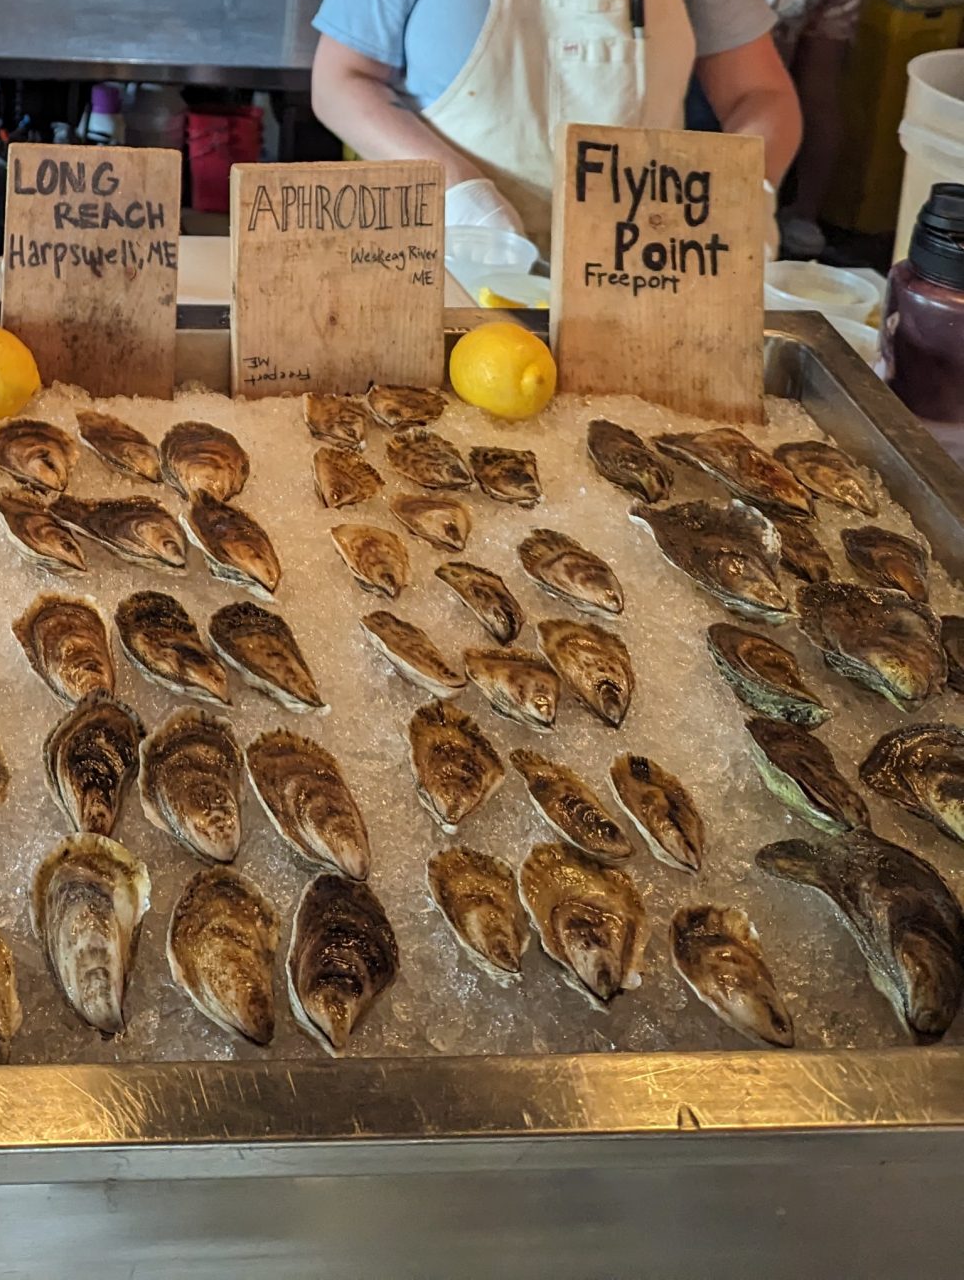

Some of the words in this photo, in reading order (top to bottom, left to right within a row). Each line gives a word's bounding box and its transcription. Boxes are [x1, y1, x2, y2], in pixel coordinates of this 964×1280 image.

[13, 159, 121, 197] LONG
[575, 141, 710, 227] Flying
[53, 201, 165, 230] REACH
[247, 182, 437, 232] APHRODITE
[147, 241, 178, 270] ME
[408, 245, 438, 260] River
[614, 222, 729, 277] Point
[412, 271, 434, 286] ME
[585, 262, 680, 297] Freeport
